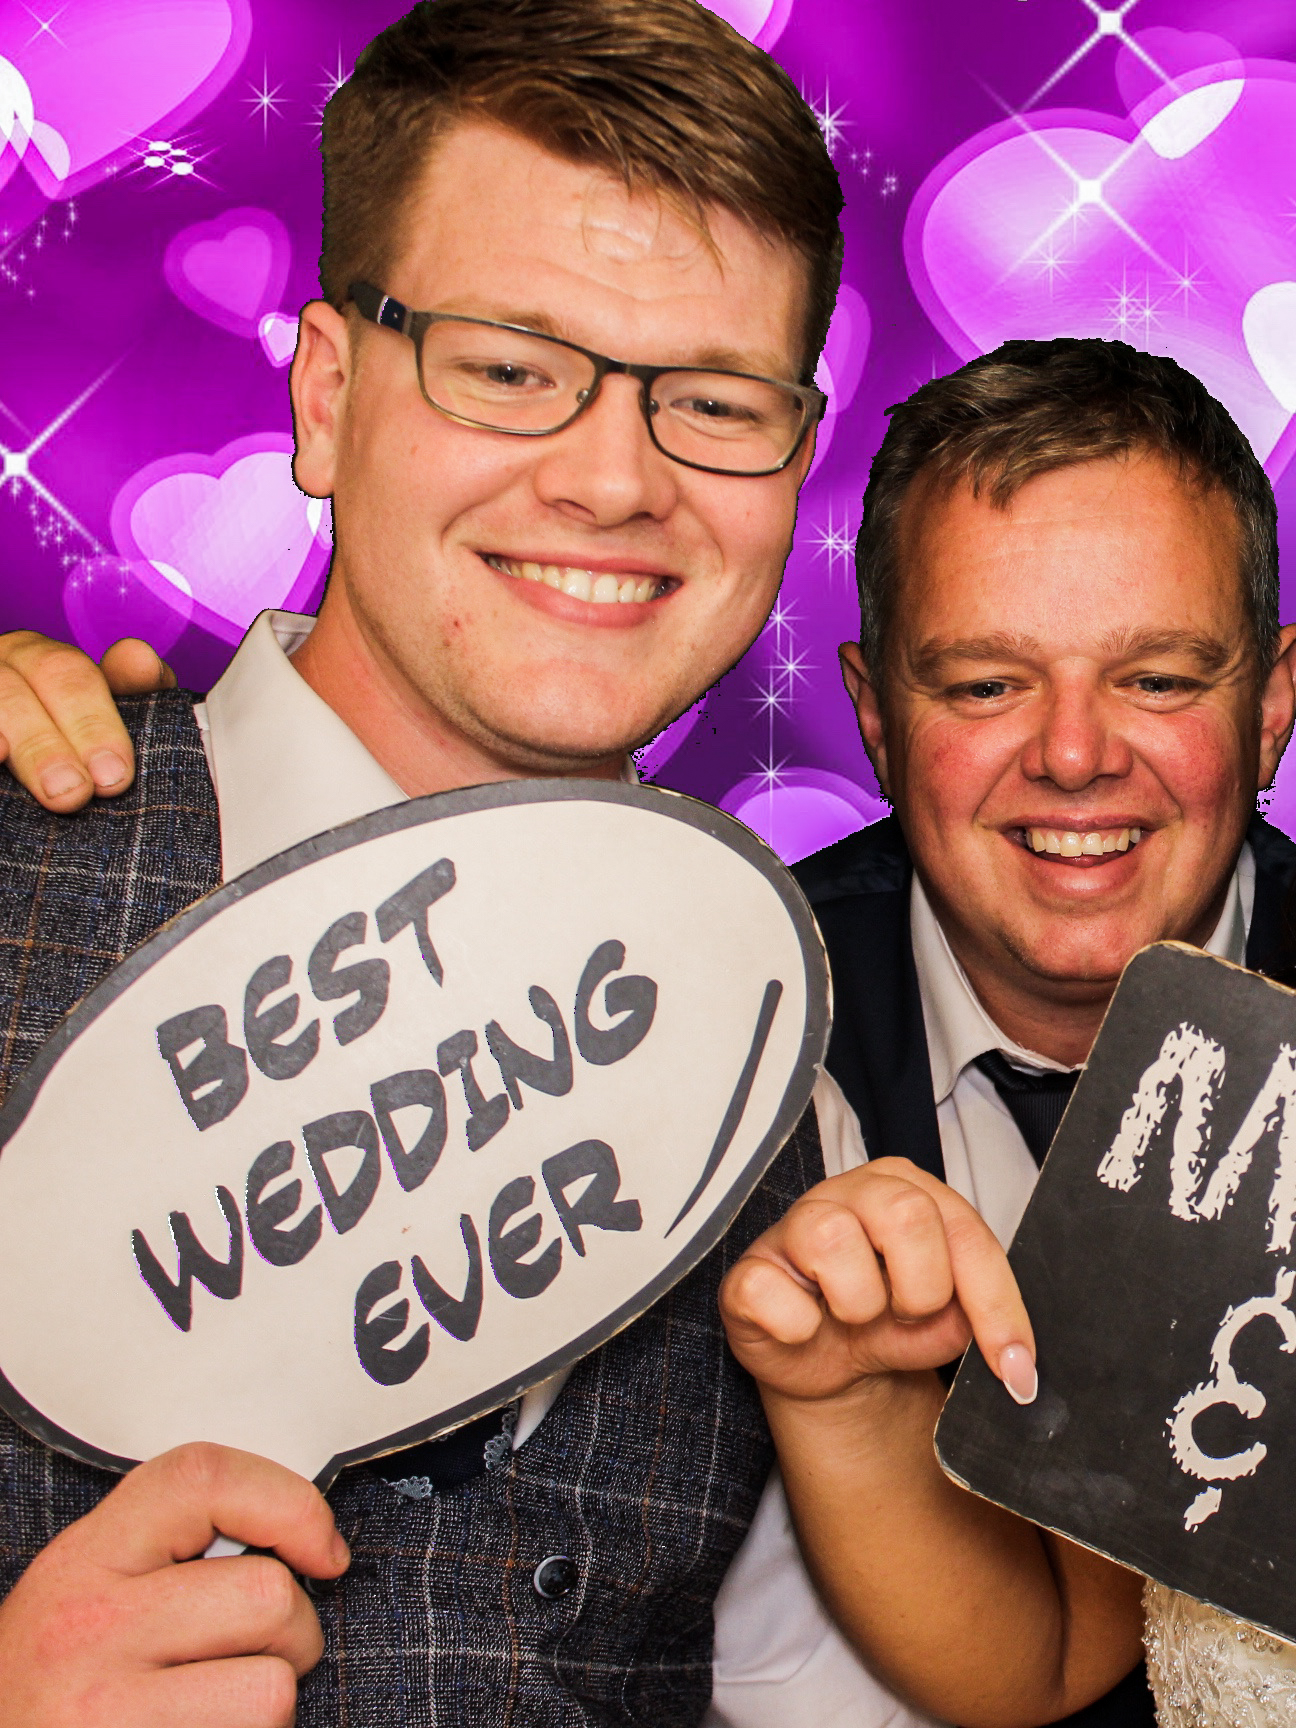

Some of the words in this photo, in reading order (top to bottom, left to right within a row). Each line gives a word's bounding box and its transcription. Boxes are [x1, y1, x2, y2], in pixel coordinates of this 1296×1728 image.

[156, 857, 457, 1131] BEST
[132, 939, 658, 1333] WEDDING
[354, 1139, 643, 1386] EVER
